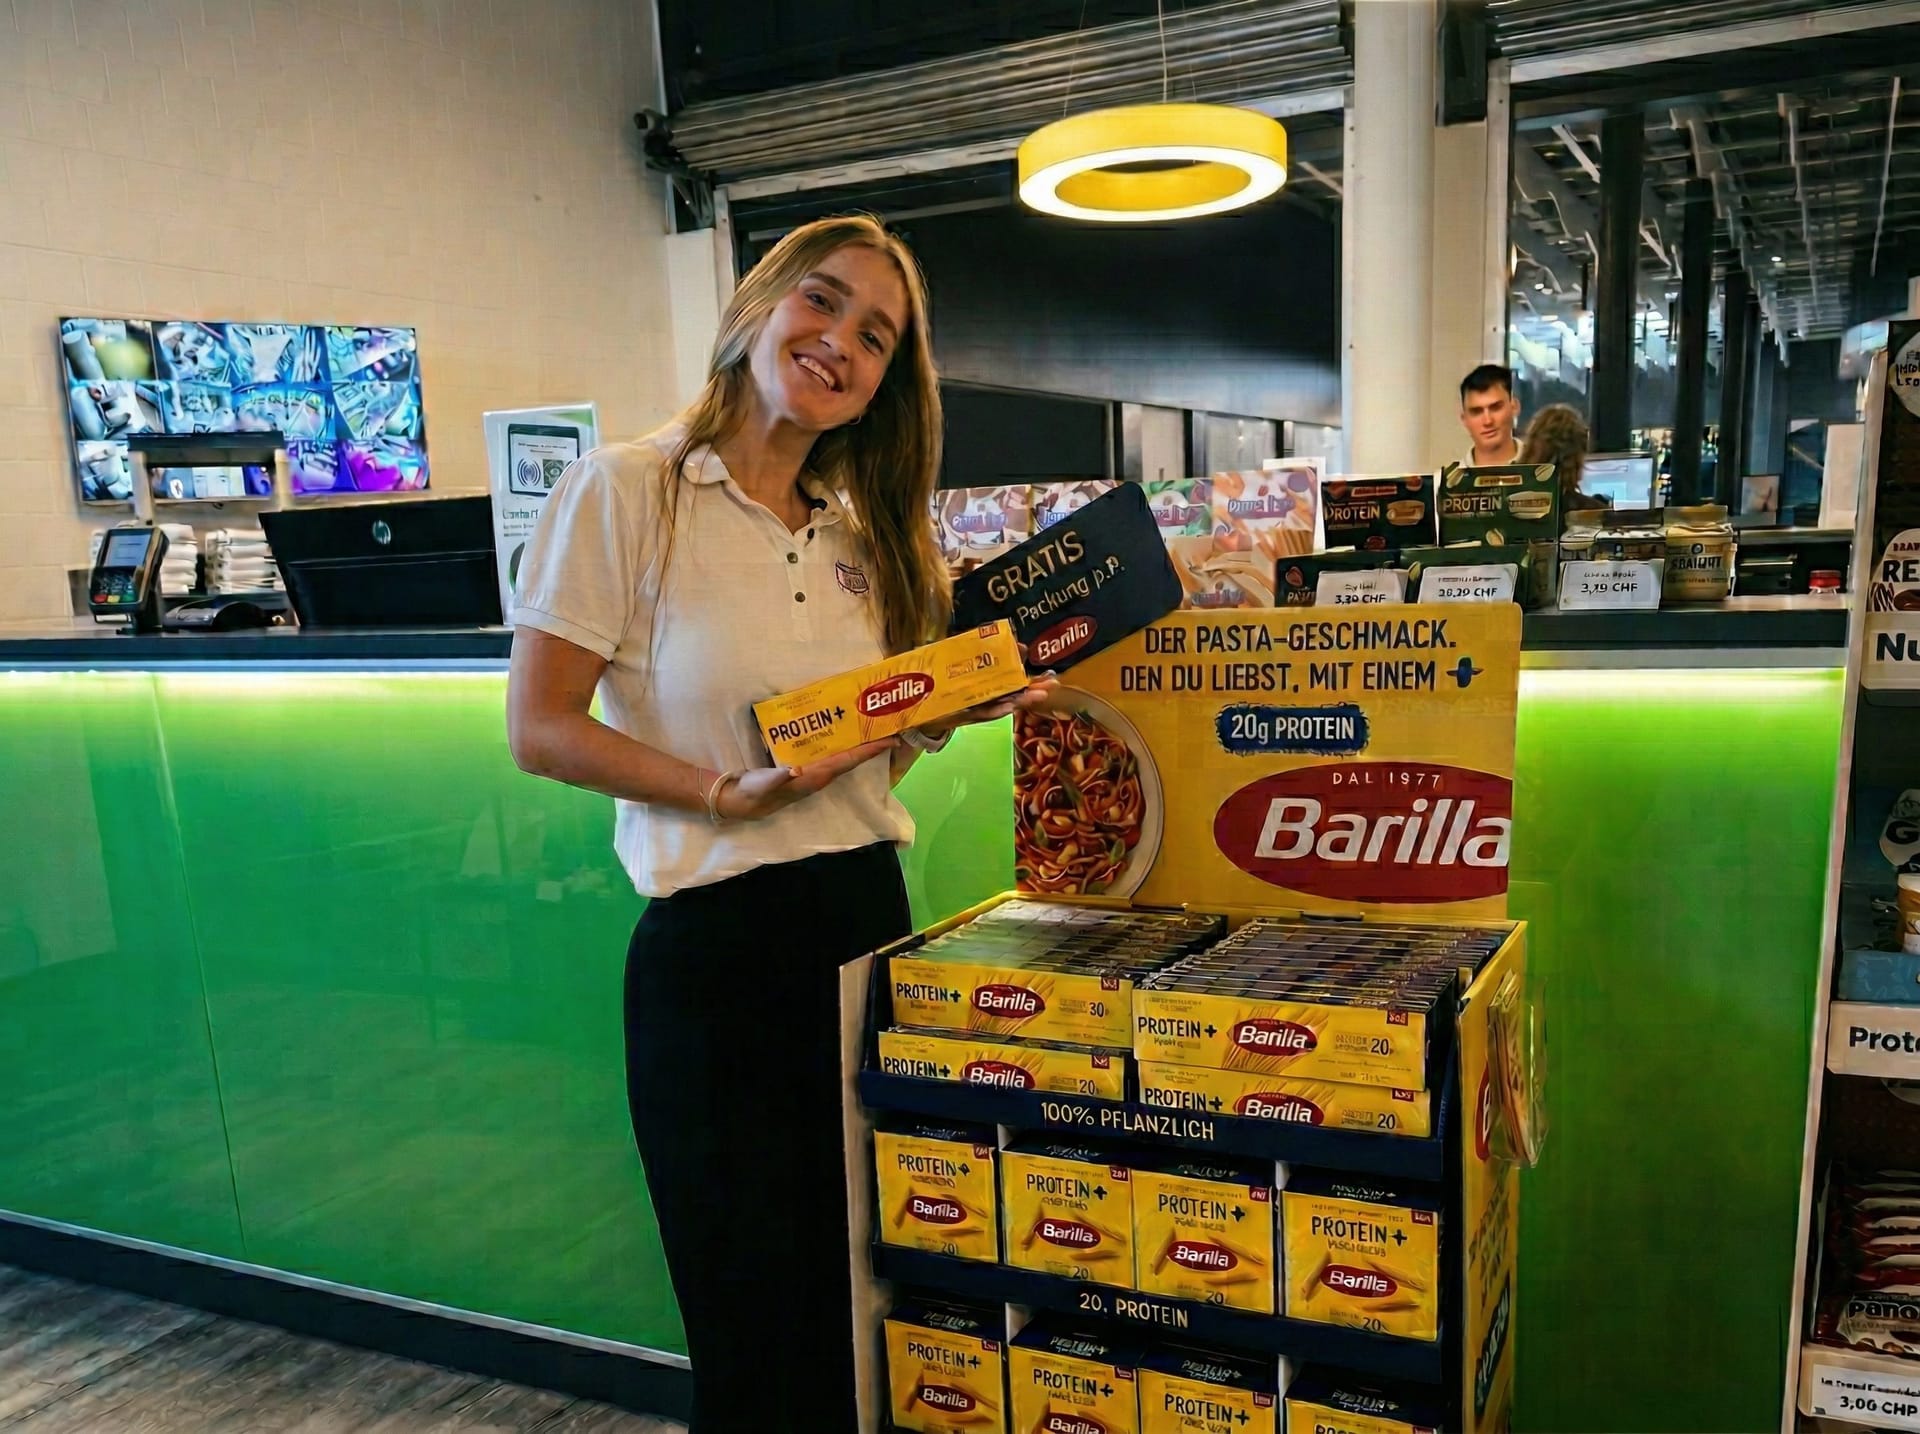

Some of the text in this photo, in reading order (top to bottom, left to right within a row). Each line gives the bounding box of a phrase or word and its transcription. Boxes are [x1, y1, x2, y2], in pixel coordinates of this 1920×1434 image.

[1324, 504, 1381, 521] PROTEIN
[1443, 495, 1502, 512] PROTEIN
[986, 530, 1085, 603] GRATIS
[1362, 593, 1388, 605] CHF
[1474, 587, 1499, 598] CHF
[1612, 582, 1639, 593] CHF
[1145, 626, 1187, 655] DER
[1120, 664, 1163, 693] DEN
[1170, 663, 1203, 691] DU
[1309, 661, 1354, 691] MIT
[1362, 660, 1437, 692] EINEM
[865, 677, 927, 713] Barilla
[1230, 714, 1356, 746] 20g PROTEIN
[1332, 771, 1375, 786] DAL
[1253, 797, 1512, 868] Barilla
[977, 990, 1037, 1013] Barilla
[1238, 1024, 1308, 1051] Barilla
[1370, 1037, 1391, 1056] 20
[969, 1066, 1026, 1090] Barilla
[1079, 1079, 1096, 1096] 20
[1040, 1101, 1215, 1142] 100% PFLANZLICH
[1244, 1098, 1314, 1125] Barilla
[1376, 1112, 1397, 1130] 20
[912, 1199, 960, 1219] Barilla
[1042, 1222, 1094, 1244] Barilla
[1174, 1244, 1230, 1268] Barilla
[1328, 1270, 1389, 1293] Barilla
[1115, 1298, 1189, 1330] PROTEIN
[922, 1387, 969, 1409] Barilla
